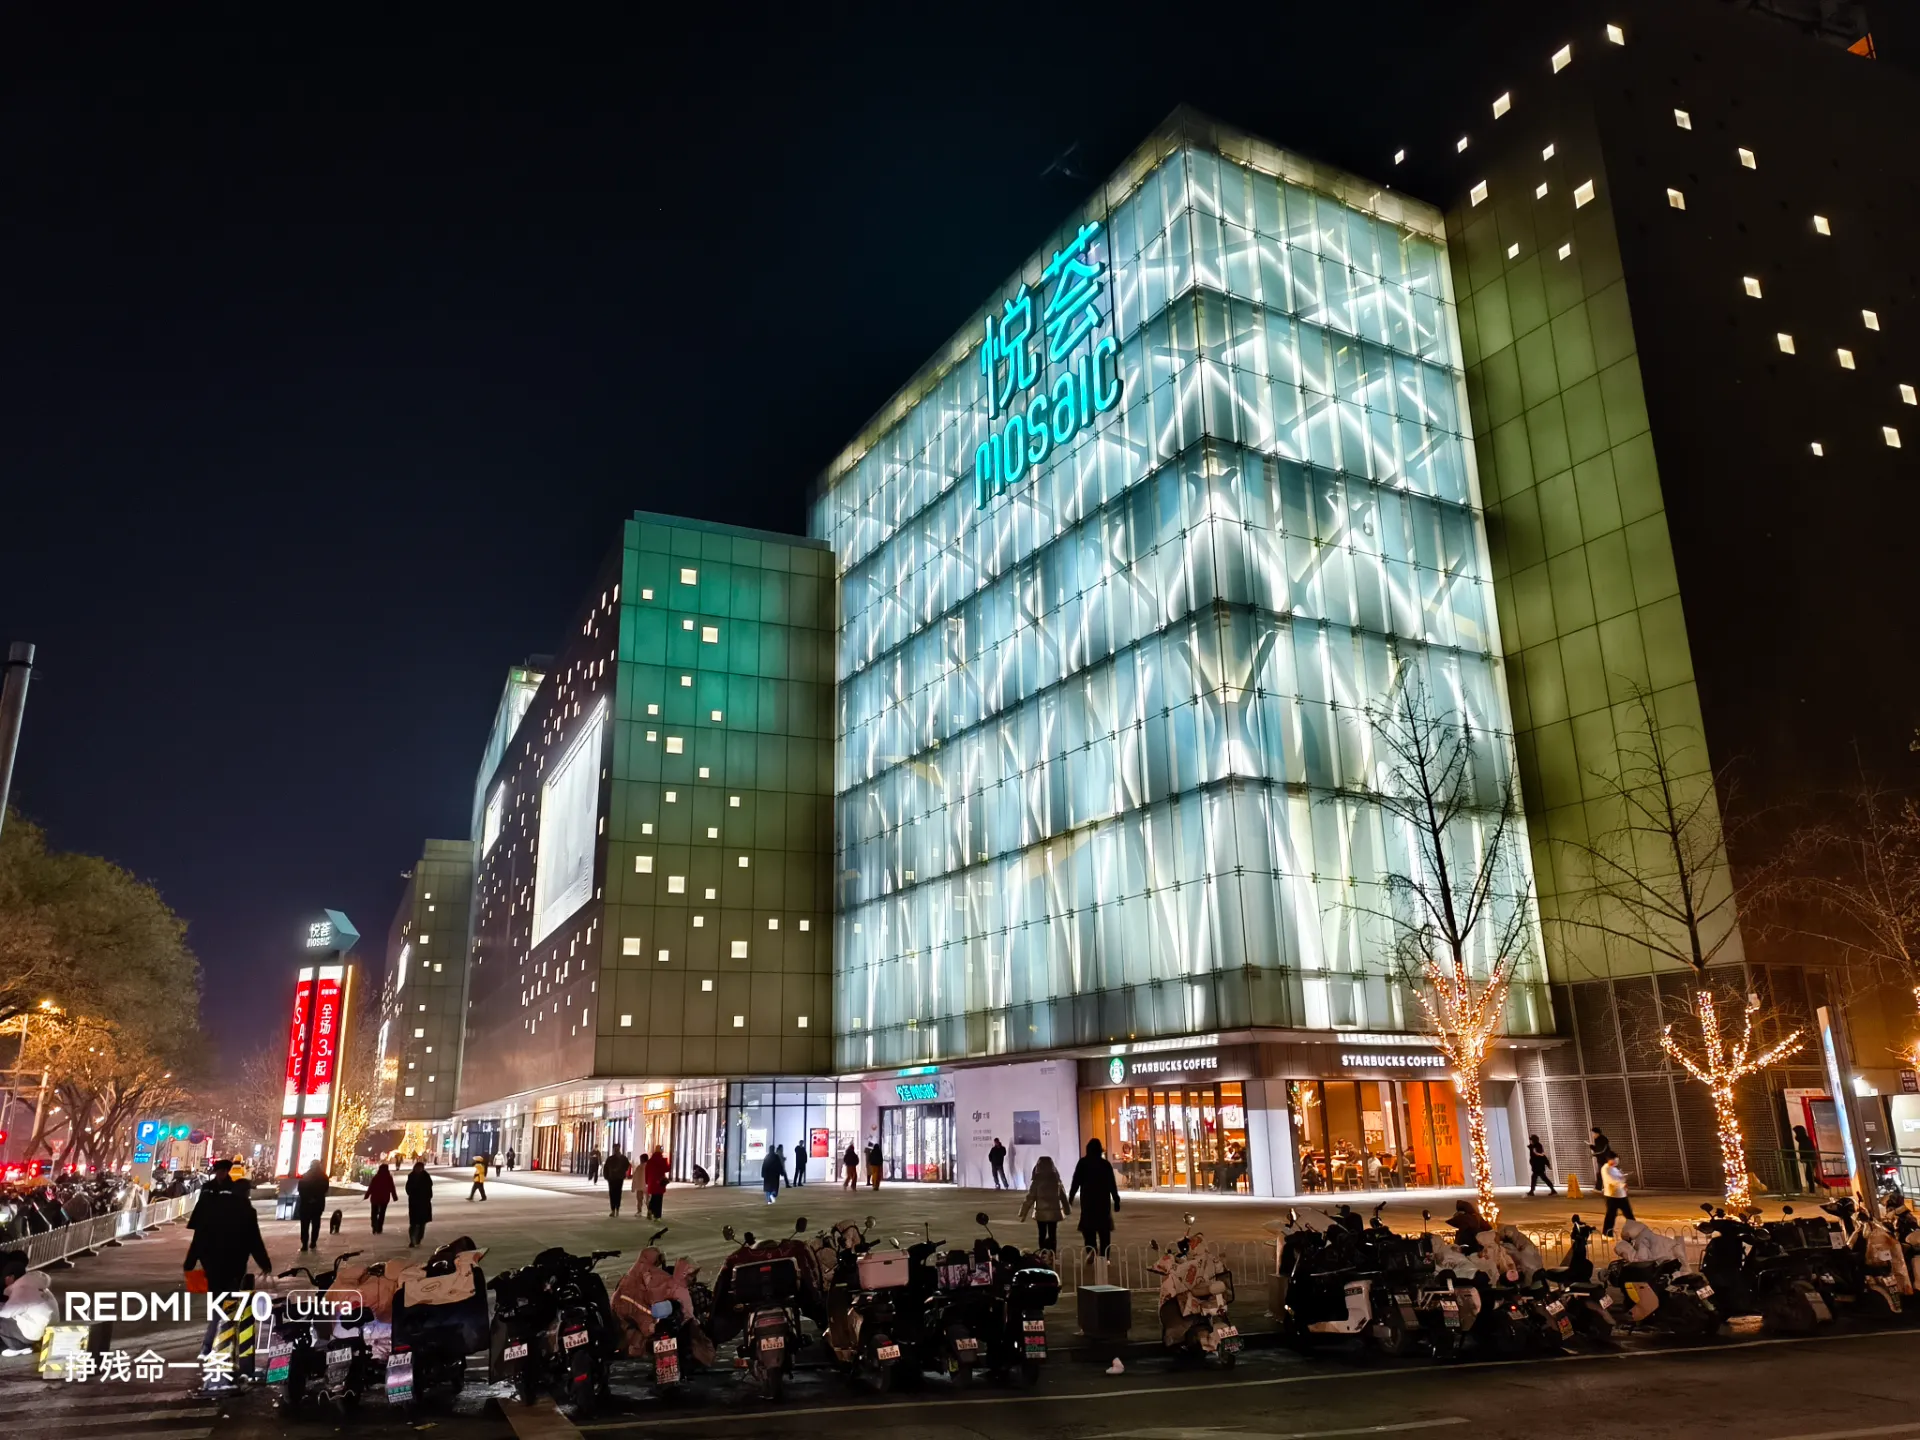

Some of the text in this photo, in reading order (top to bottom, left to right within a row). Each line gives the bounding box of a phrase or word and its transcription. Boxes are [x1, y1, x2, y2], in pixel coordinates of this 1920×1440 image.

[981, 220, 1105, 420] 悦荟
[309, 922, 332, 937] 悦荟
[314, 1003, 333, 1078] 全场3起
[1131, 1057, 1218, 1075] STARBUCKS COFFEE
[1341, 1055, 1446, 1067] STARBUCKS COFFEE
[141, 1123, 154, 1138] P
